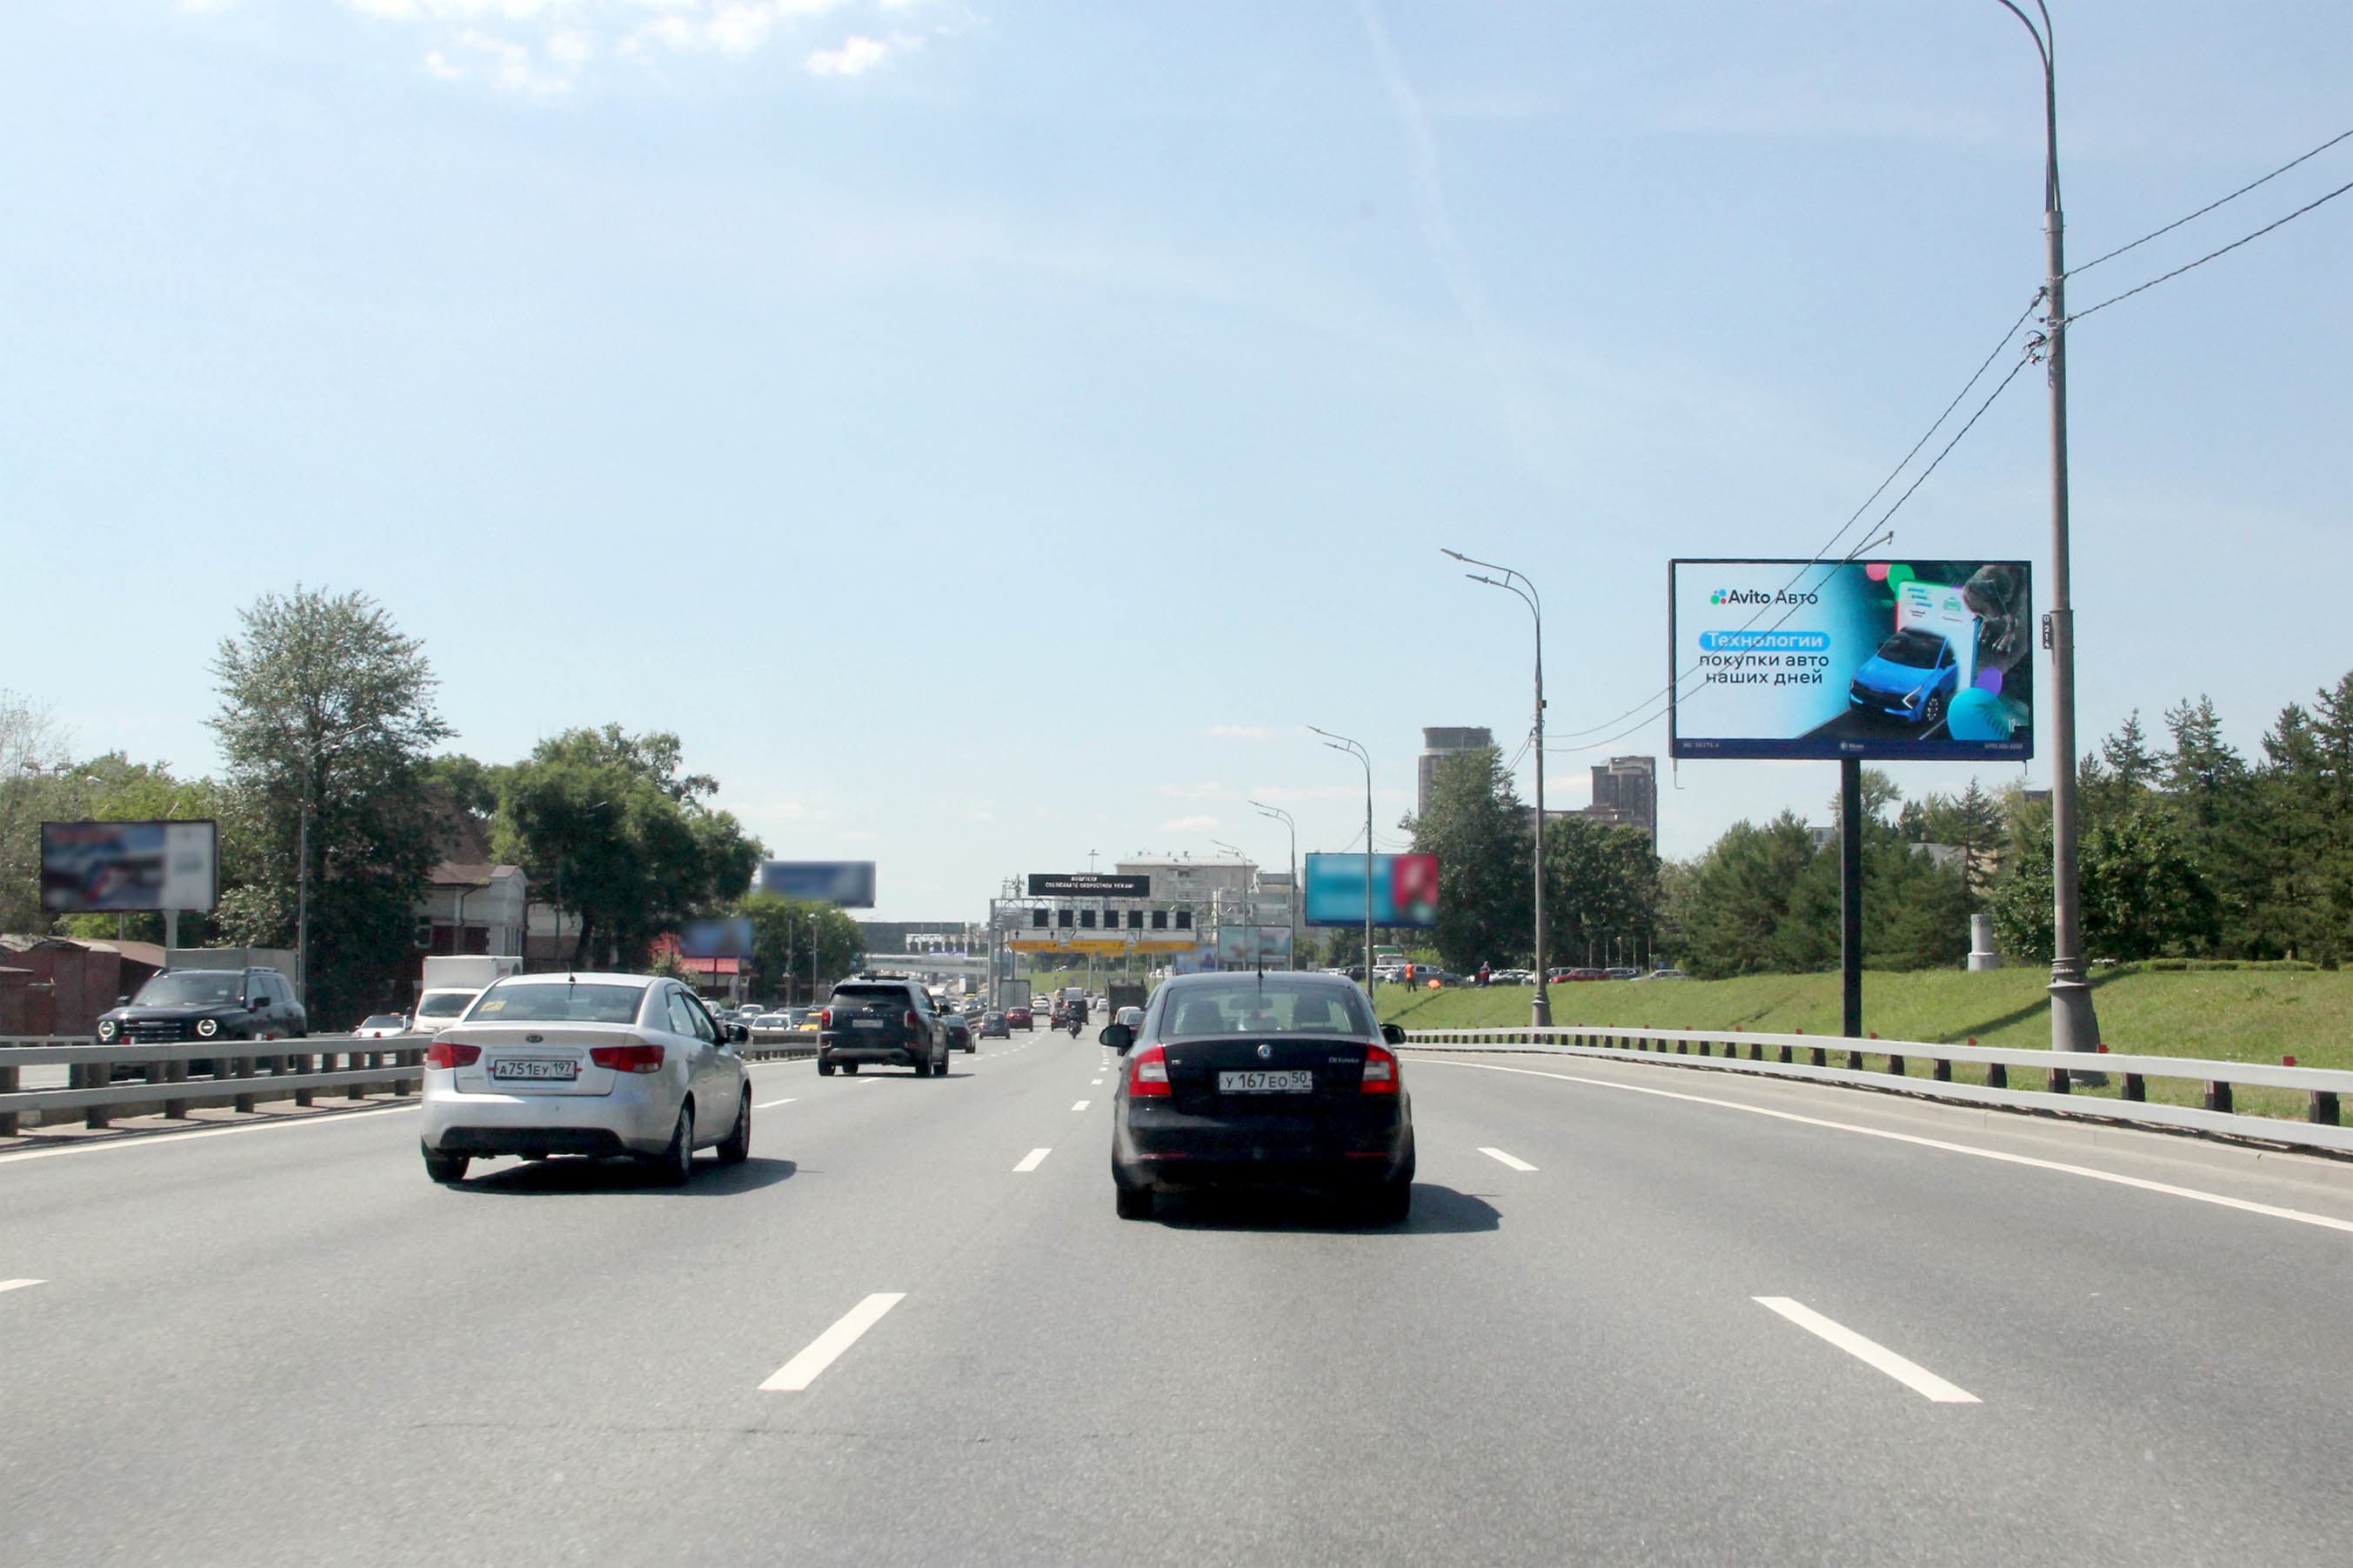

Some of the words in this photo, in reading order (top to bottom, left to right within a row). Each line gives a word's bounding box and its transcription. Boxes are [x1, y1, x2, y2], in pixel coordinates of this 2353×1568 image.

[1728, 590, 1770, 604] Avito
[1775, 590, 1818, 604] Авто
[1708, 632, 1823, 647] Технологии
[1700, 656, 1780, 669] покупки
[1786, 656, 1829, 666] авто
[1706, 672, 1768, 684] наших
[1774, 669, 1823, 685] дней
[1292, 1071, 1307, 1084] 50
